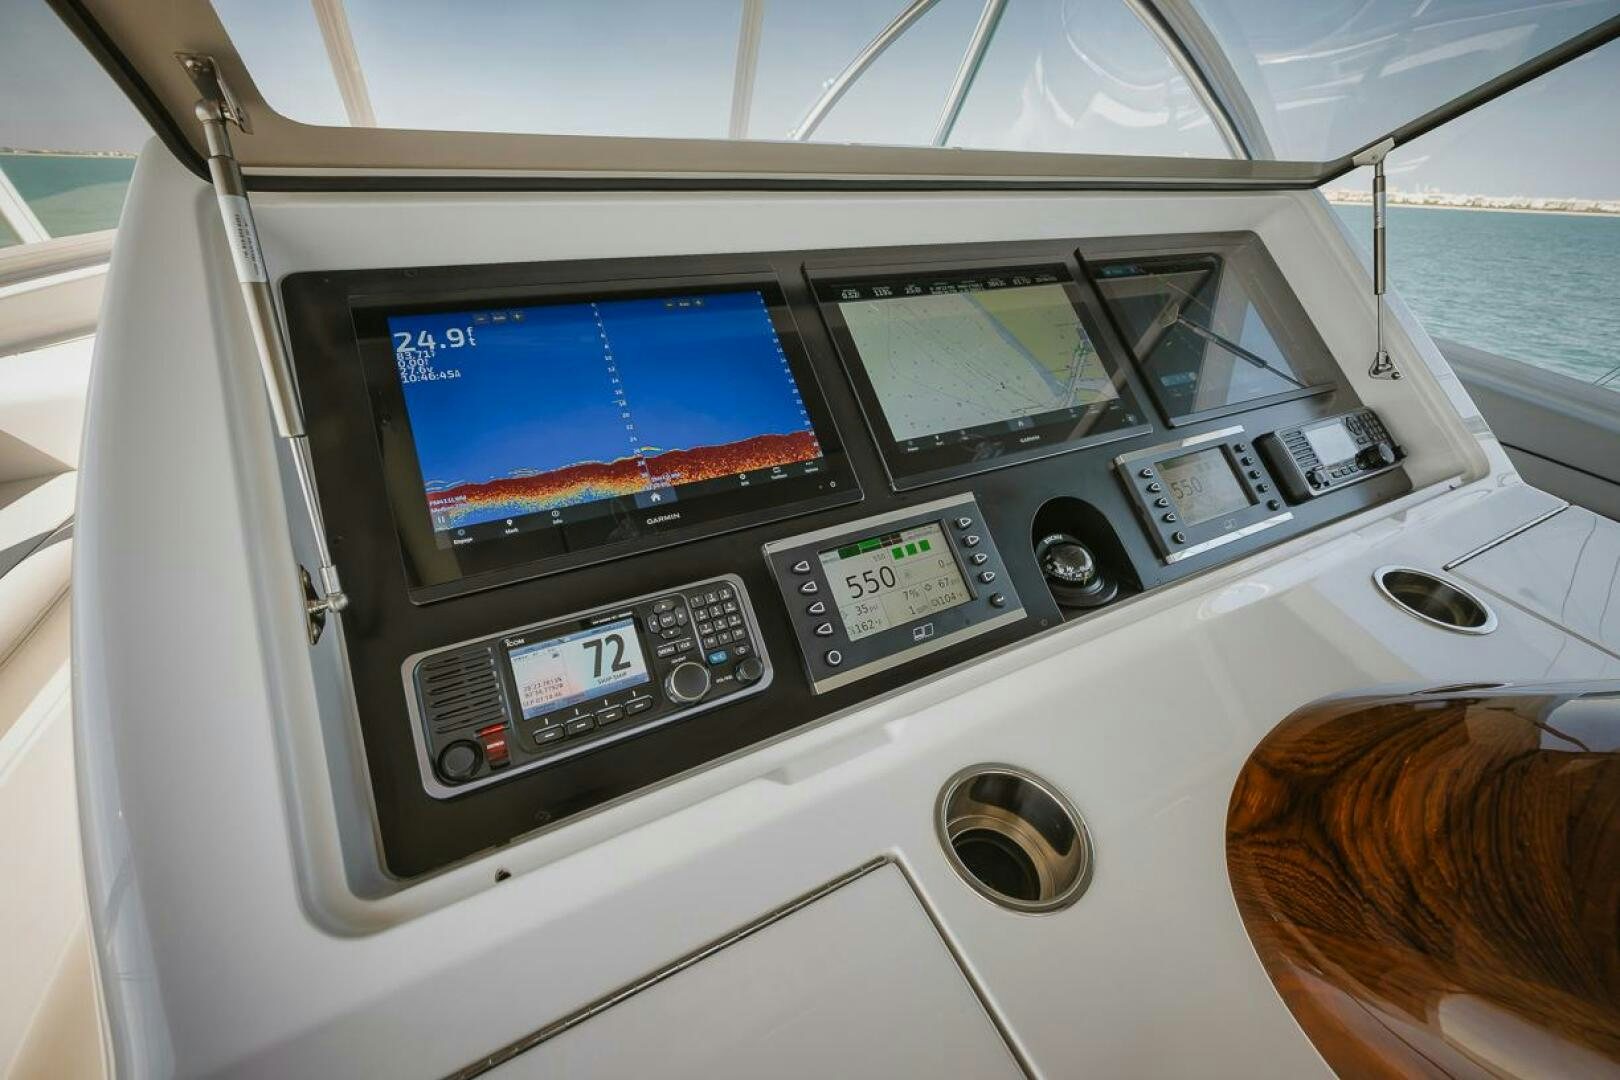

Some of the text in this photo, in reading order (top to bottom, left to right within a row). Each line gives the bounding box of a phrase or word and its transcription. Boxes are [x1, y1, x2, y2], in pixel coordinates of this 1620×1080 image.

[646, 512, 681, 526] GARMIN
[845, 565, 897, 599] 550
[582, 633, 632, 679] 72
